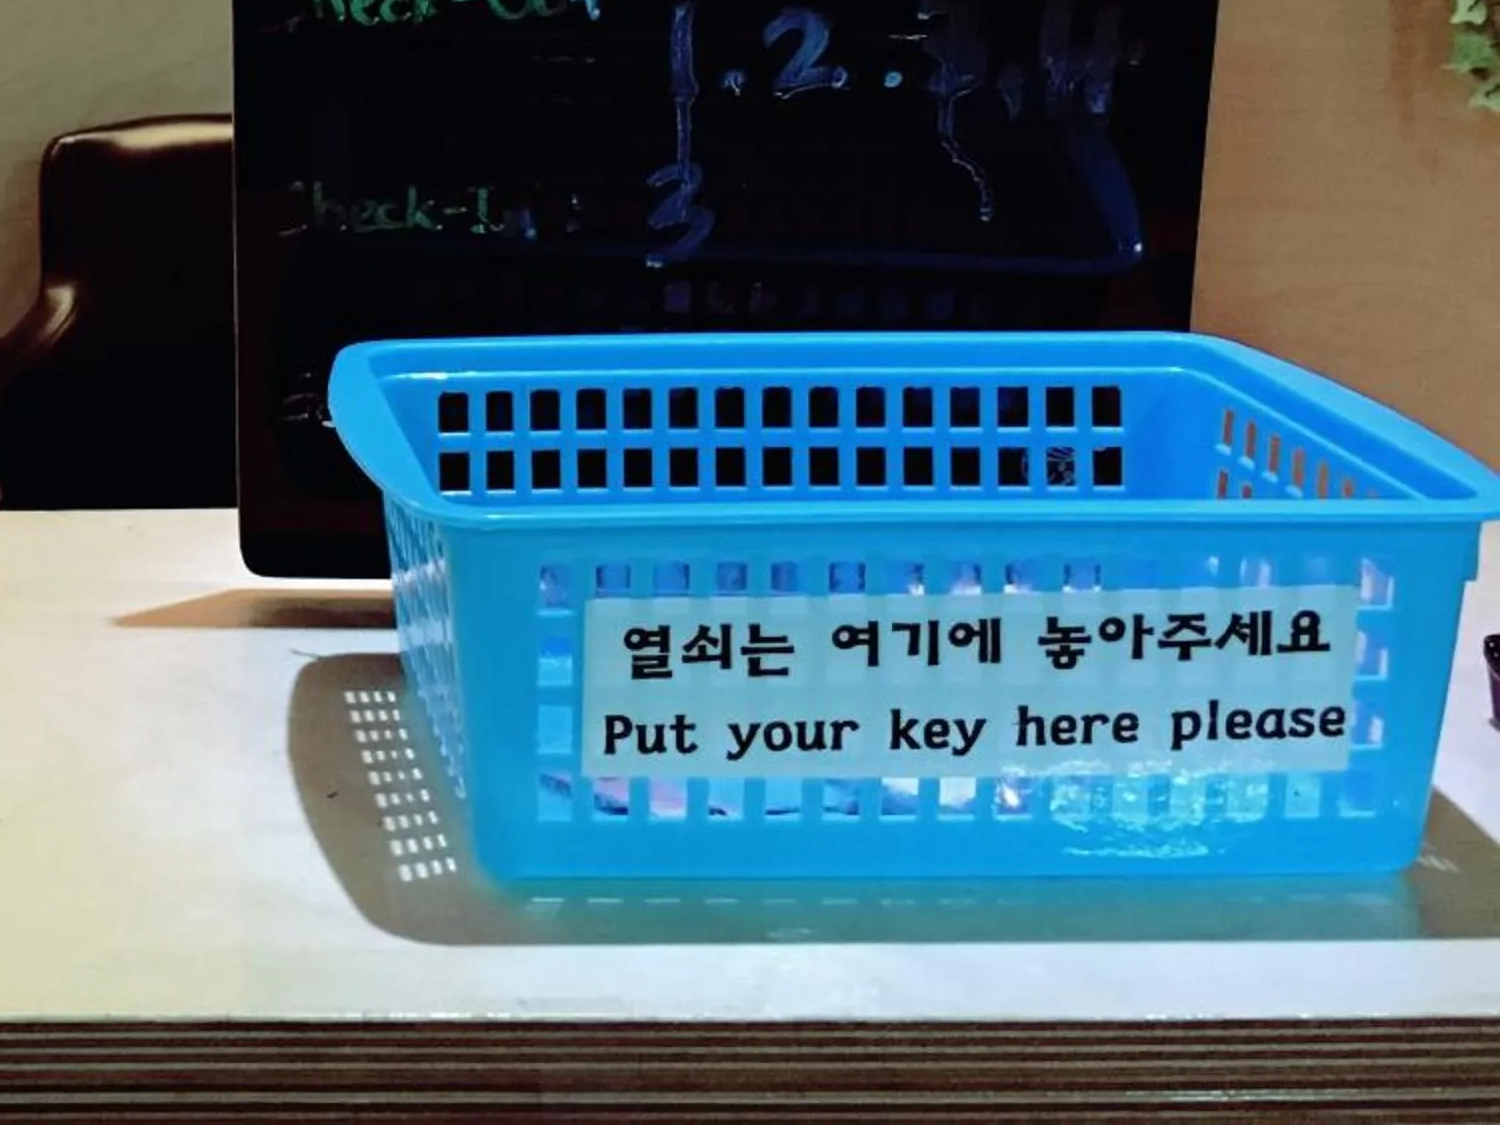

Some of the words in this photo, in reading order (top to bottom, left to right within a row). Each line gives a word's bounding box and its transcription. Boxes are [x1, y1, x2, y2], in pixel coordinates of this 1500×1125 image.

[622, 623, 795, 678] 열쇠는
[830, 617, 1002, 668] 여기에
[1037, 610, 1332, 668] 놓아주세요
[603, 713, 699, 755] Put
[725, 720, 860, 761] your
[889, 707, 987, 755] key
[1015, 705, 1140, 747] here
[1170, 699, 1347, 751] please
